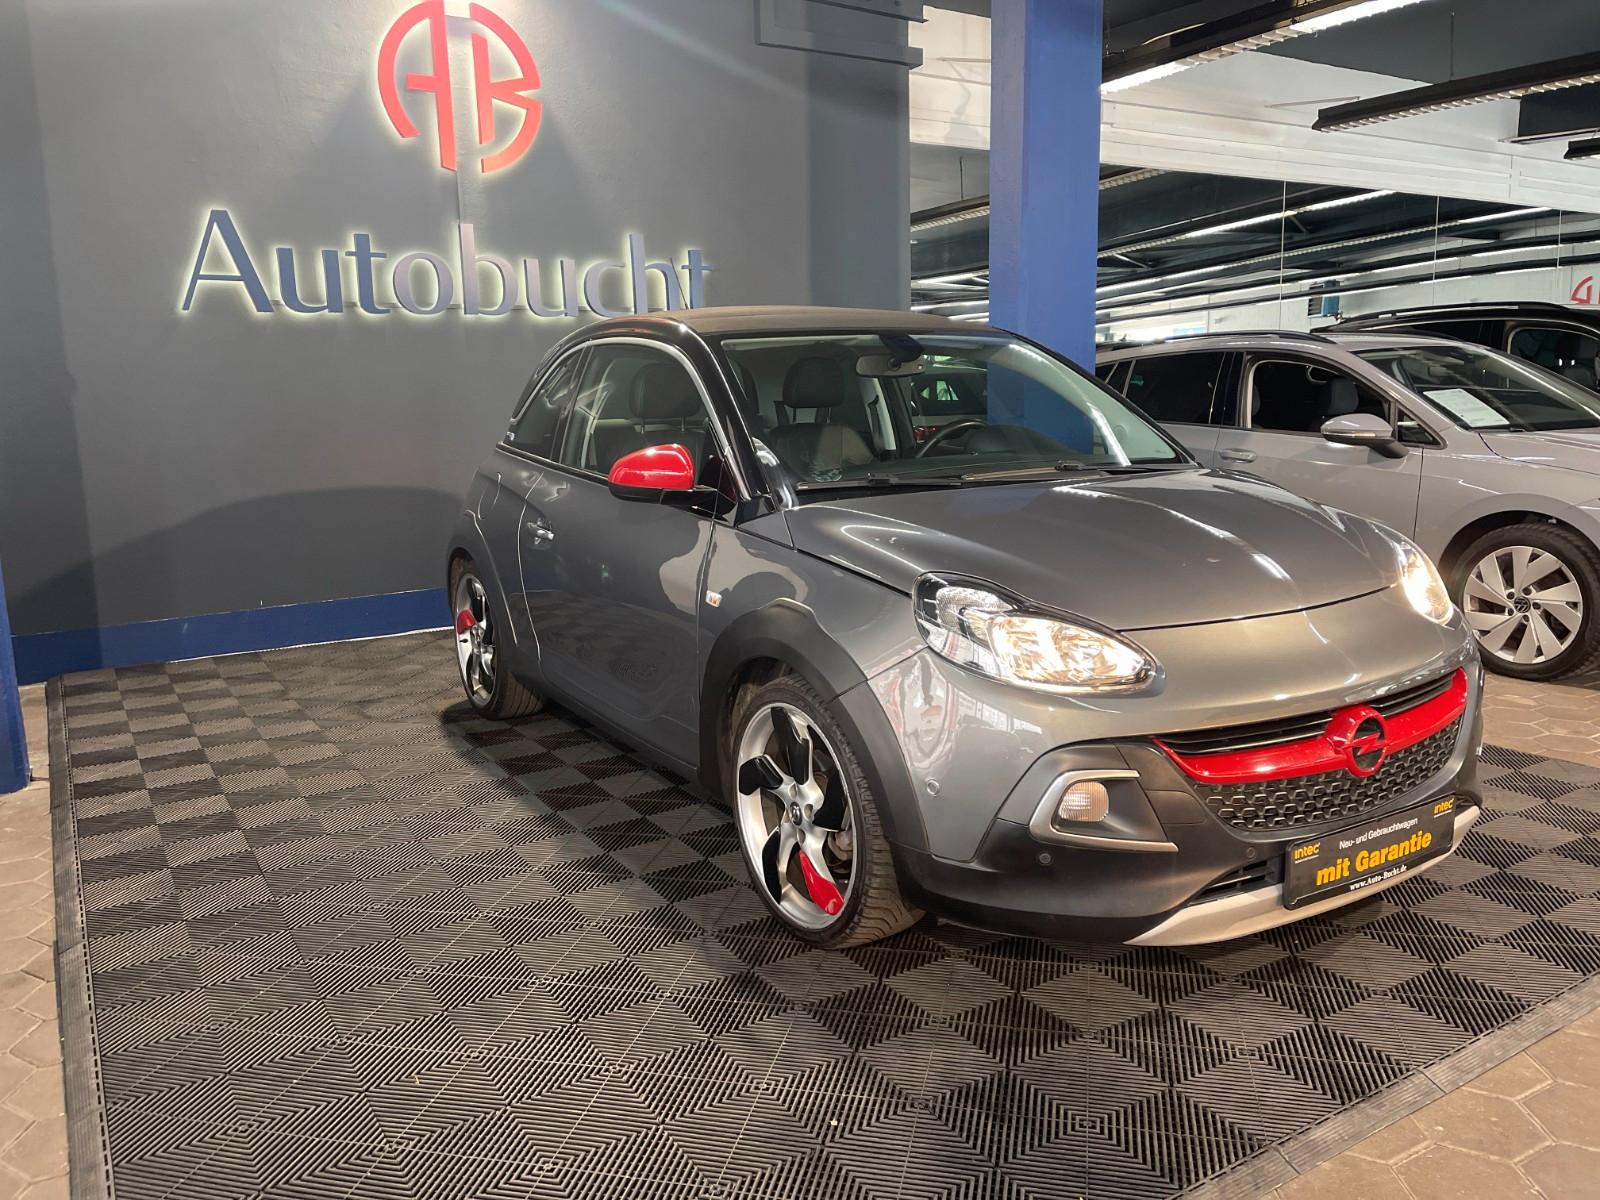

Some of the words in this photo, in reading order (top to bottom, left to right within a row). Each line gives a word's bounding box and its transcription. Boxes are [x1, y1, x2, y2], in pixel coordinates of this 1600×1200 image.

[182, 208, 712, 318] Autobucht
[1368, 817, 1418, 840] Gebrauchtwagen
[1316, 857, 1351, 886] mit
[1355, 830, 1432, 872] Garantie
